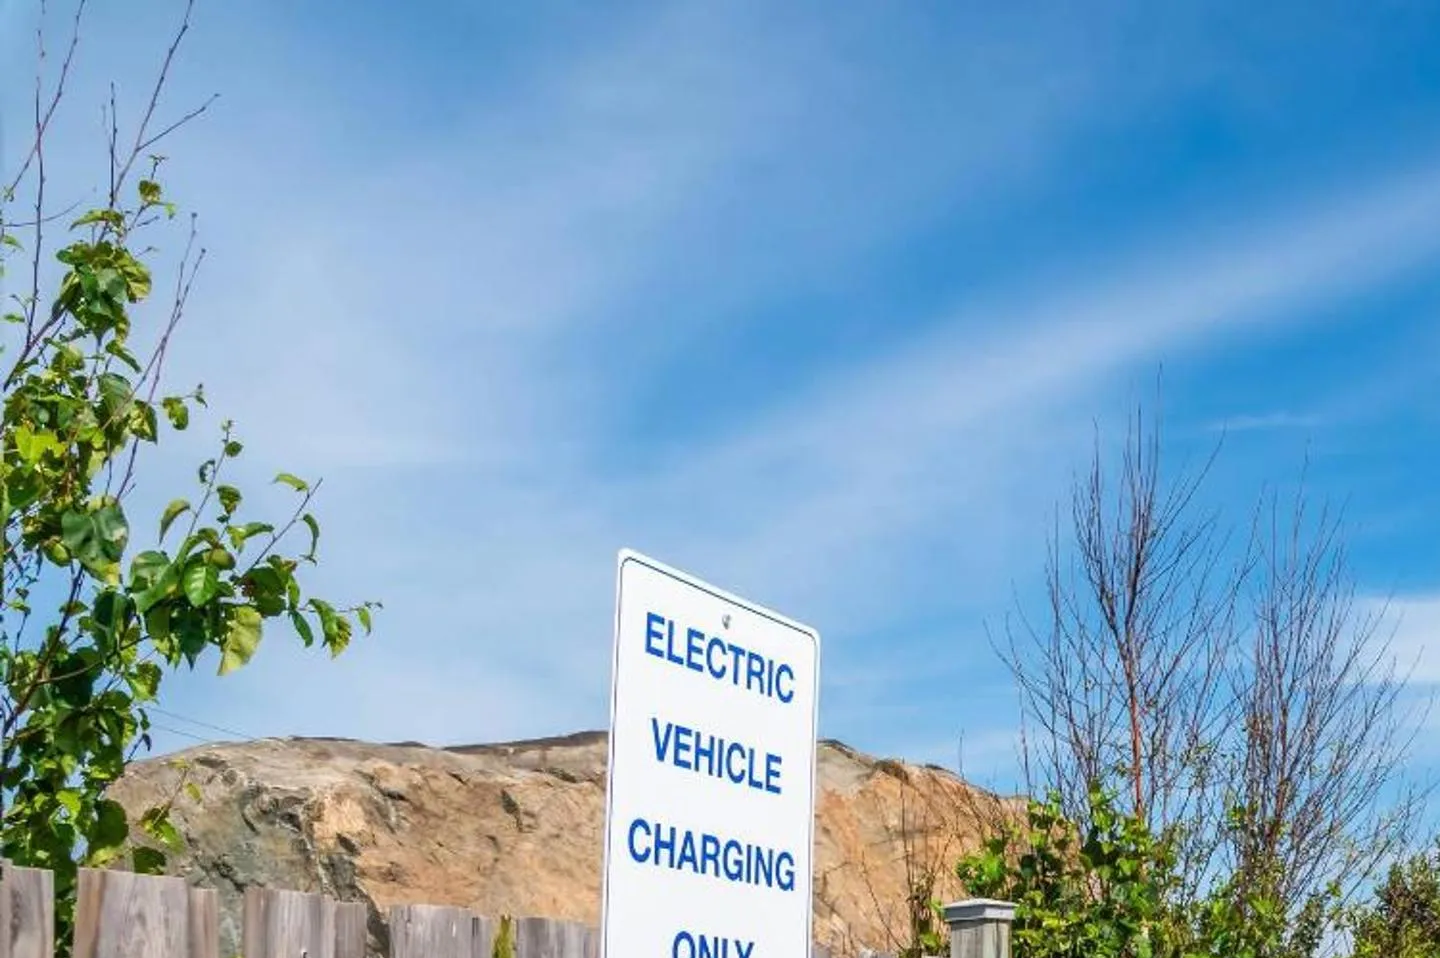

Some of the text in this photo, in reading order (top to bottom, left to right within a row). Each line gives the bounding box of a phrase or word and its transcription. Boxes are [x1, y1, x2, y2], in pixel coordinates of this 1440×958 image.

[645, 611, 795, 704] ELECTRIC
[652, 717, 782, 795] VEHICLE
[628, 818, 795, 892] CHARGING
